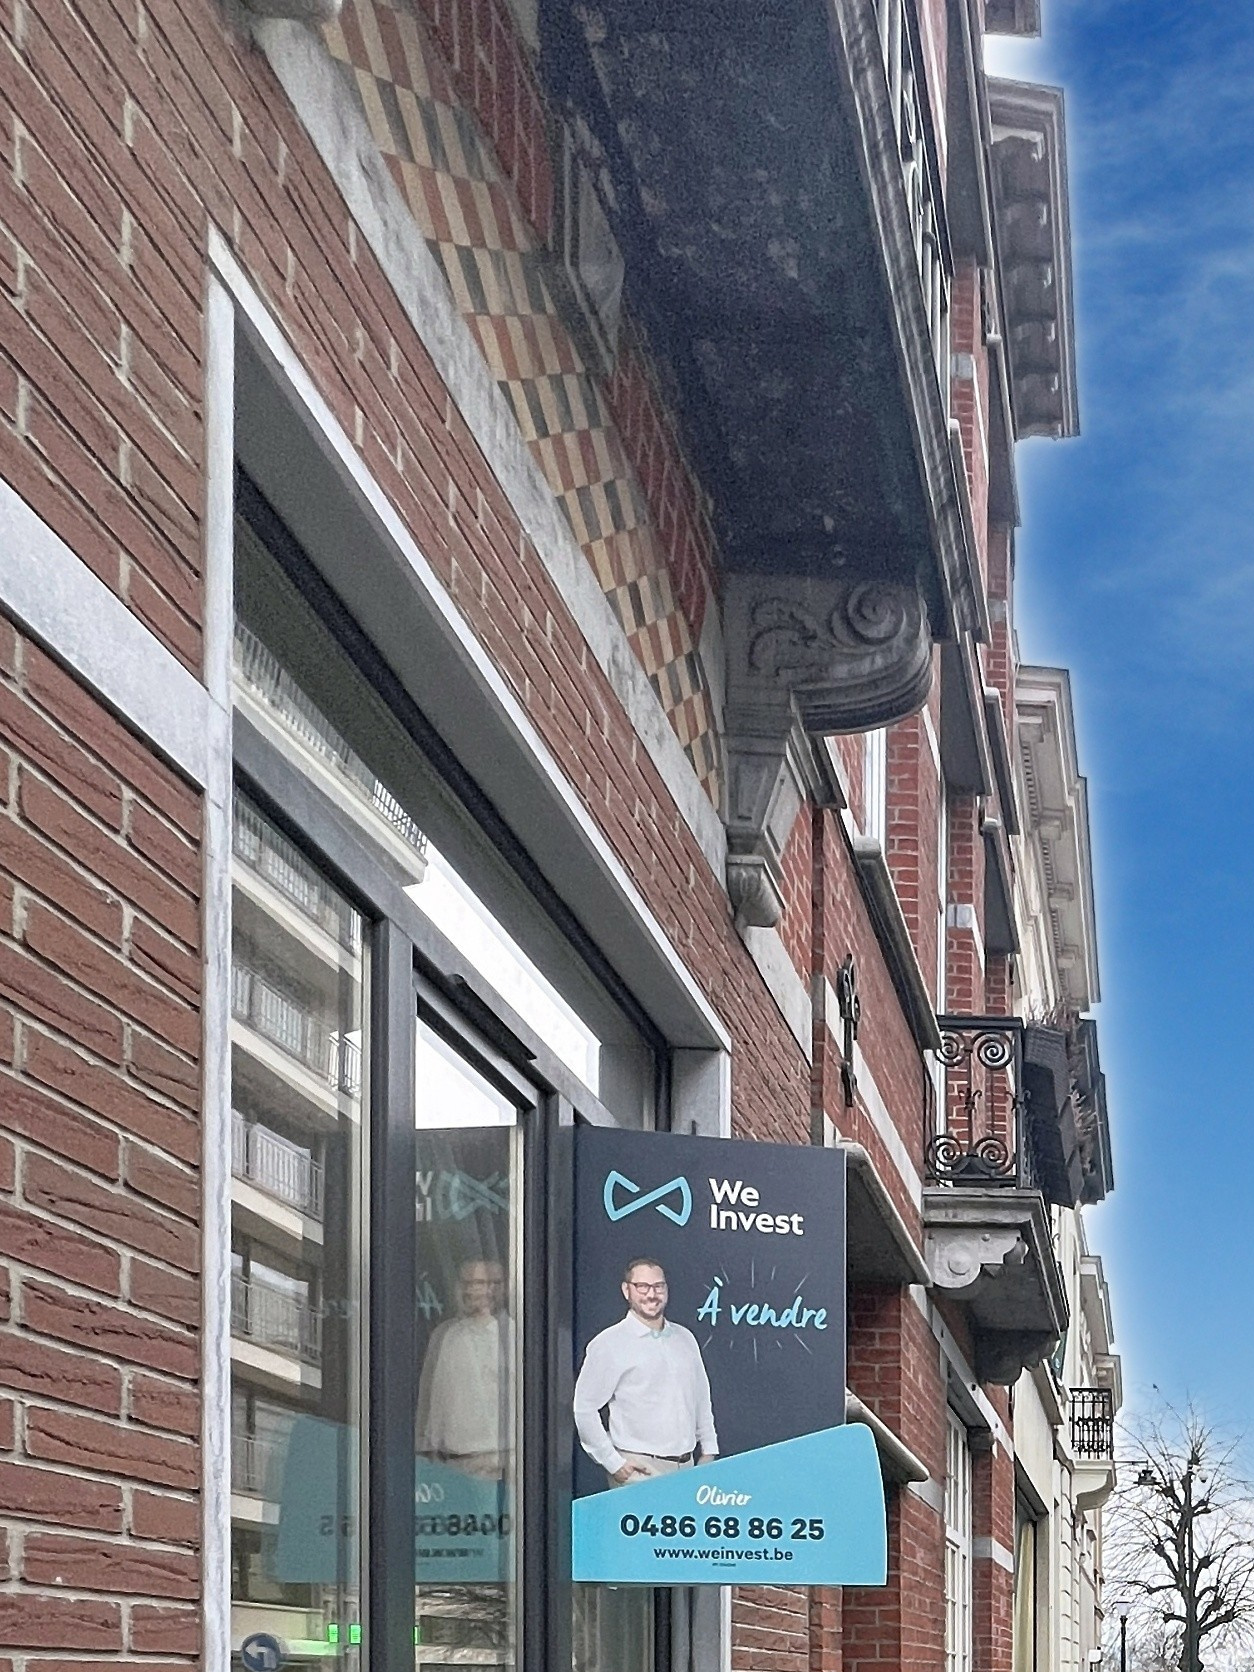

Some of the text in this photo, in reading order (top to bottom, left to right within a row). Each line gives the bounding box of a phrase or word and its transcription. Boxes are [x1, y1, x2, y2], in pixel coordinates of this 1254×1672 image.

[708, 1177, 760, 1207] We
[709, 1203, 805, 1236] Invest
[697, 1276, 828, 1330] À vendre
[695, 1484, 752, 1506] Olivier
[620, 1514, 826, 1541] 0486 68 86 25
[653, 1546, 794, 1562] www.weinvest.be
